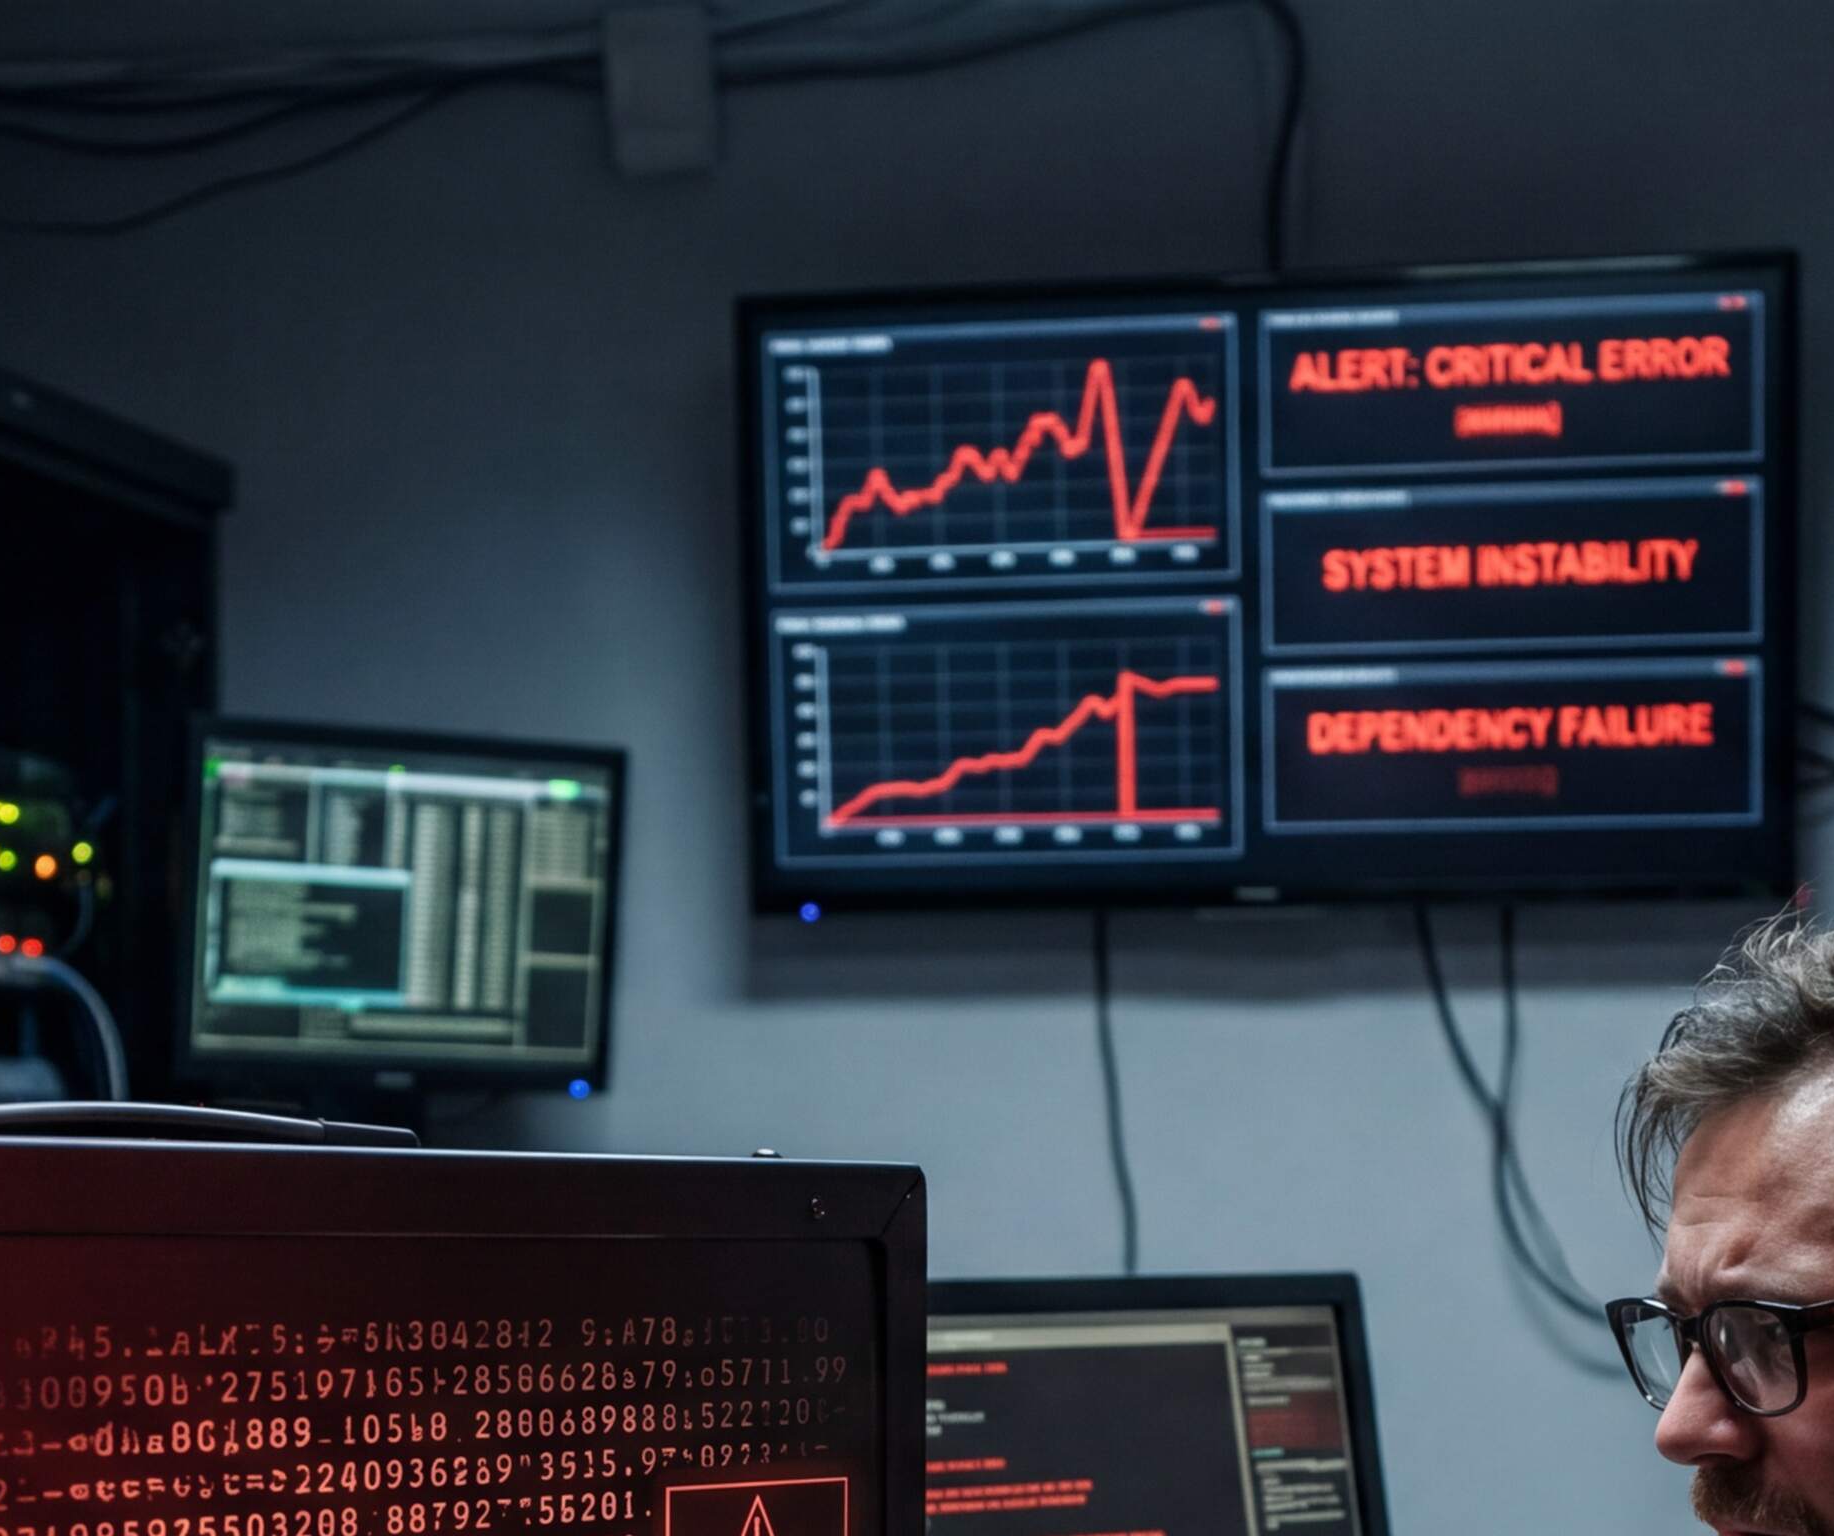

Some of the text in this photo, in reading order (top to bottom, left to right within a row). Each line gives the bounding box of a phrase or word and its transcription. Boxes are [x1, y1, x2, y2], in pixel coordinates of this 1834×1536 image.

[1288, 335, 1732, 392] ALERT: CRITICAL ERROR
[1320, 538, 1700, 592] SYSTEM INSTABILITY
[1306, 702, 1715, 755] DEPENDENCY FAILURE
